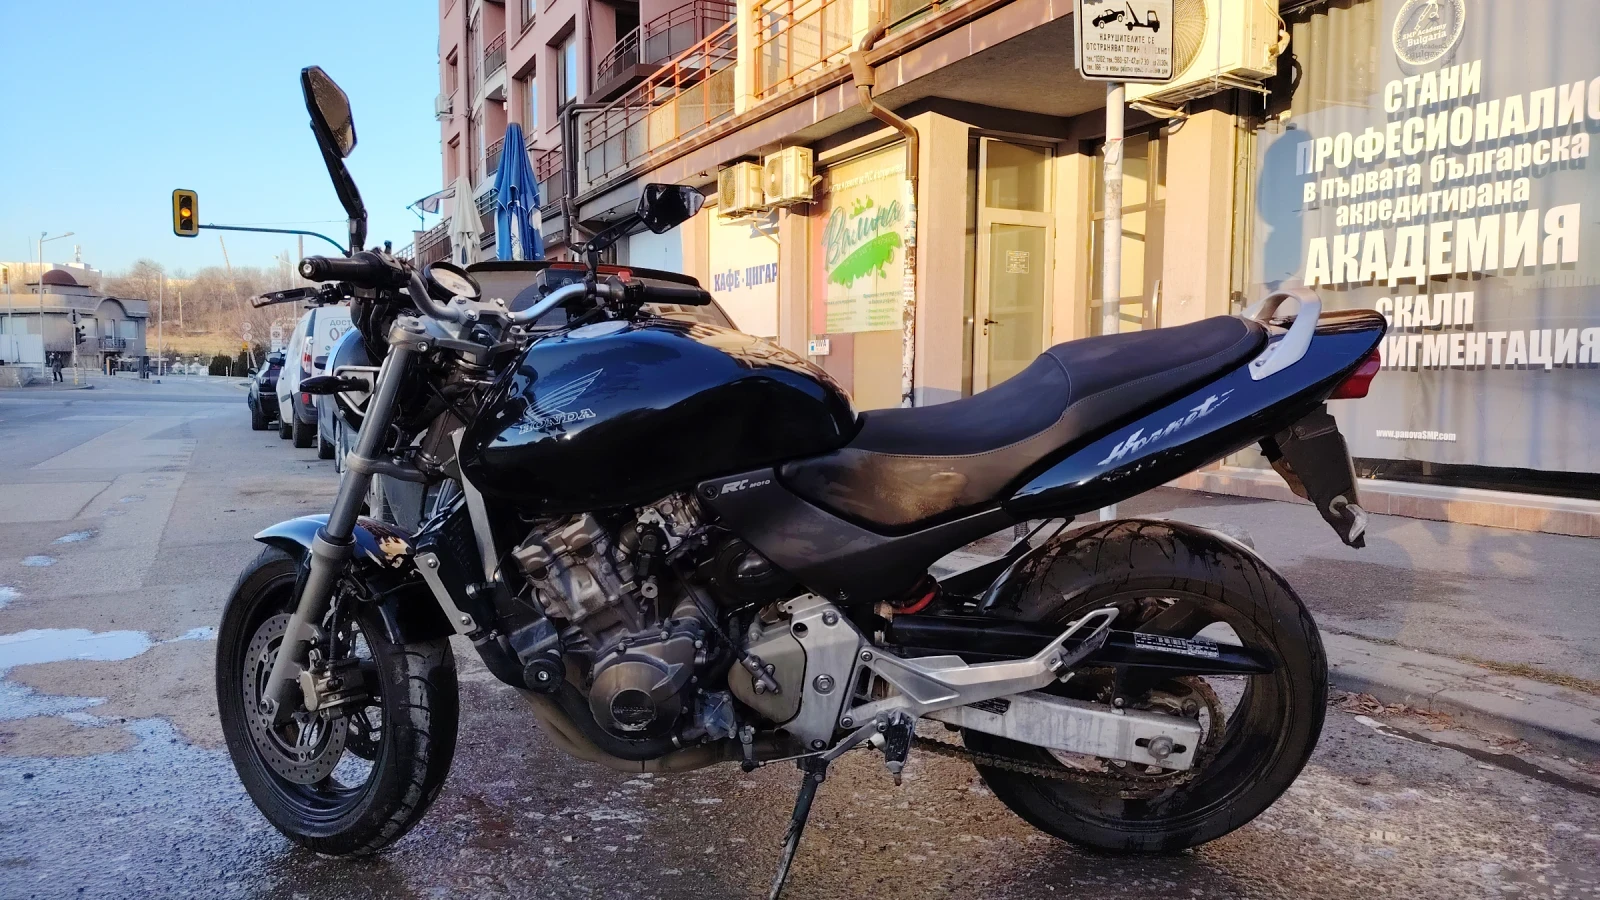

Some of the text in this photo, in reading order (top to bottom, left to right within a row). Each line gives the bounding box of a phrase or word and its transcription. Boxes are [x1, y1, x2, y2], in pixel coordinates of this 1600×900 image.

[1086, 42, 1124, 53] ОТСТРАНЯВАТ
[1099, 33, 1155, 44] НАРУШИТЕЛИТЕ СЕ
[1407, 31, 1447, 47] Bulgaria
[1384, 59, 1482, 113] СТАНИ
[1303, 132, 1590, 203] в първата българска
[1336, 176, 1529, 227] акредитирана
[1304, 203, 1581, 288] АКАДЕМИЯ
[714, 268, 740, 292] КАФЕ
[1375, 291, 1475, 327] СКАЛП
[519, 408, 596, 435] HONDA
[1097, 389, 1234, 466] Hornet
[1376, 429, 1457, 441] www.panovaSMP.com
[721, 479, 749, 494] RC
